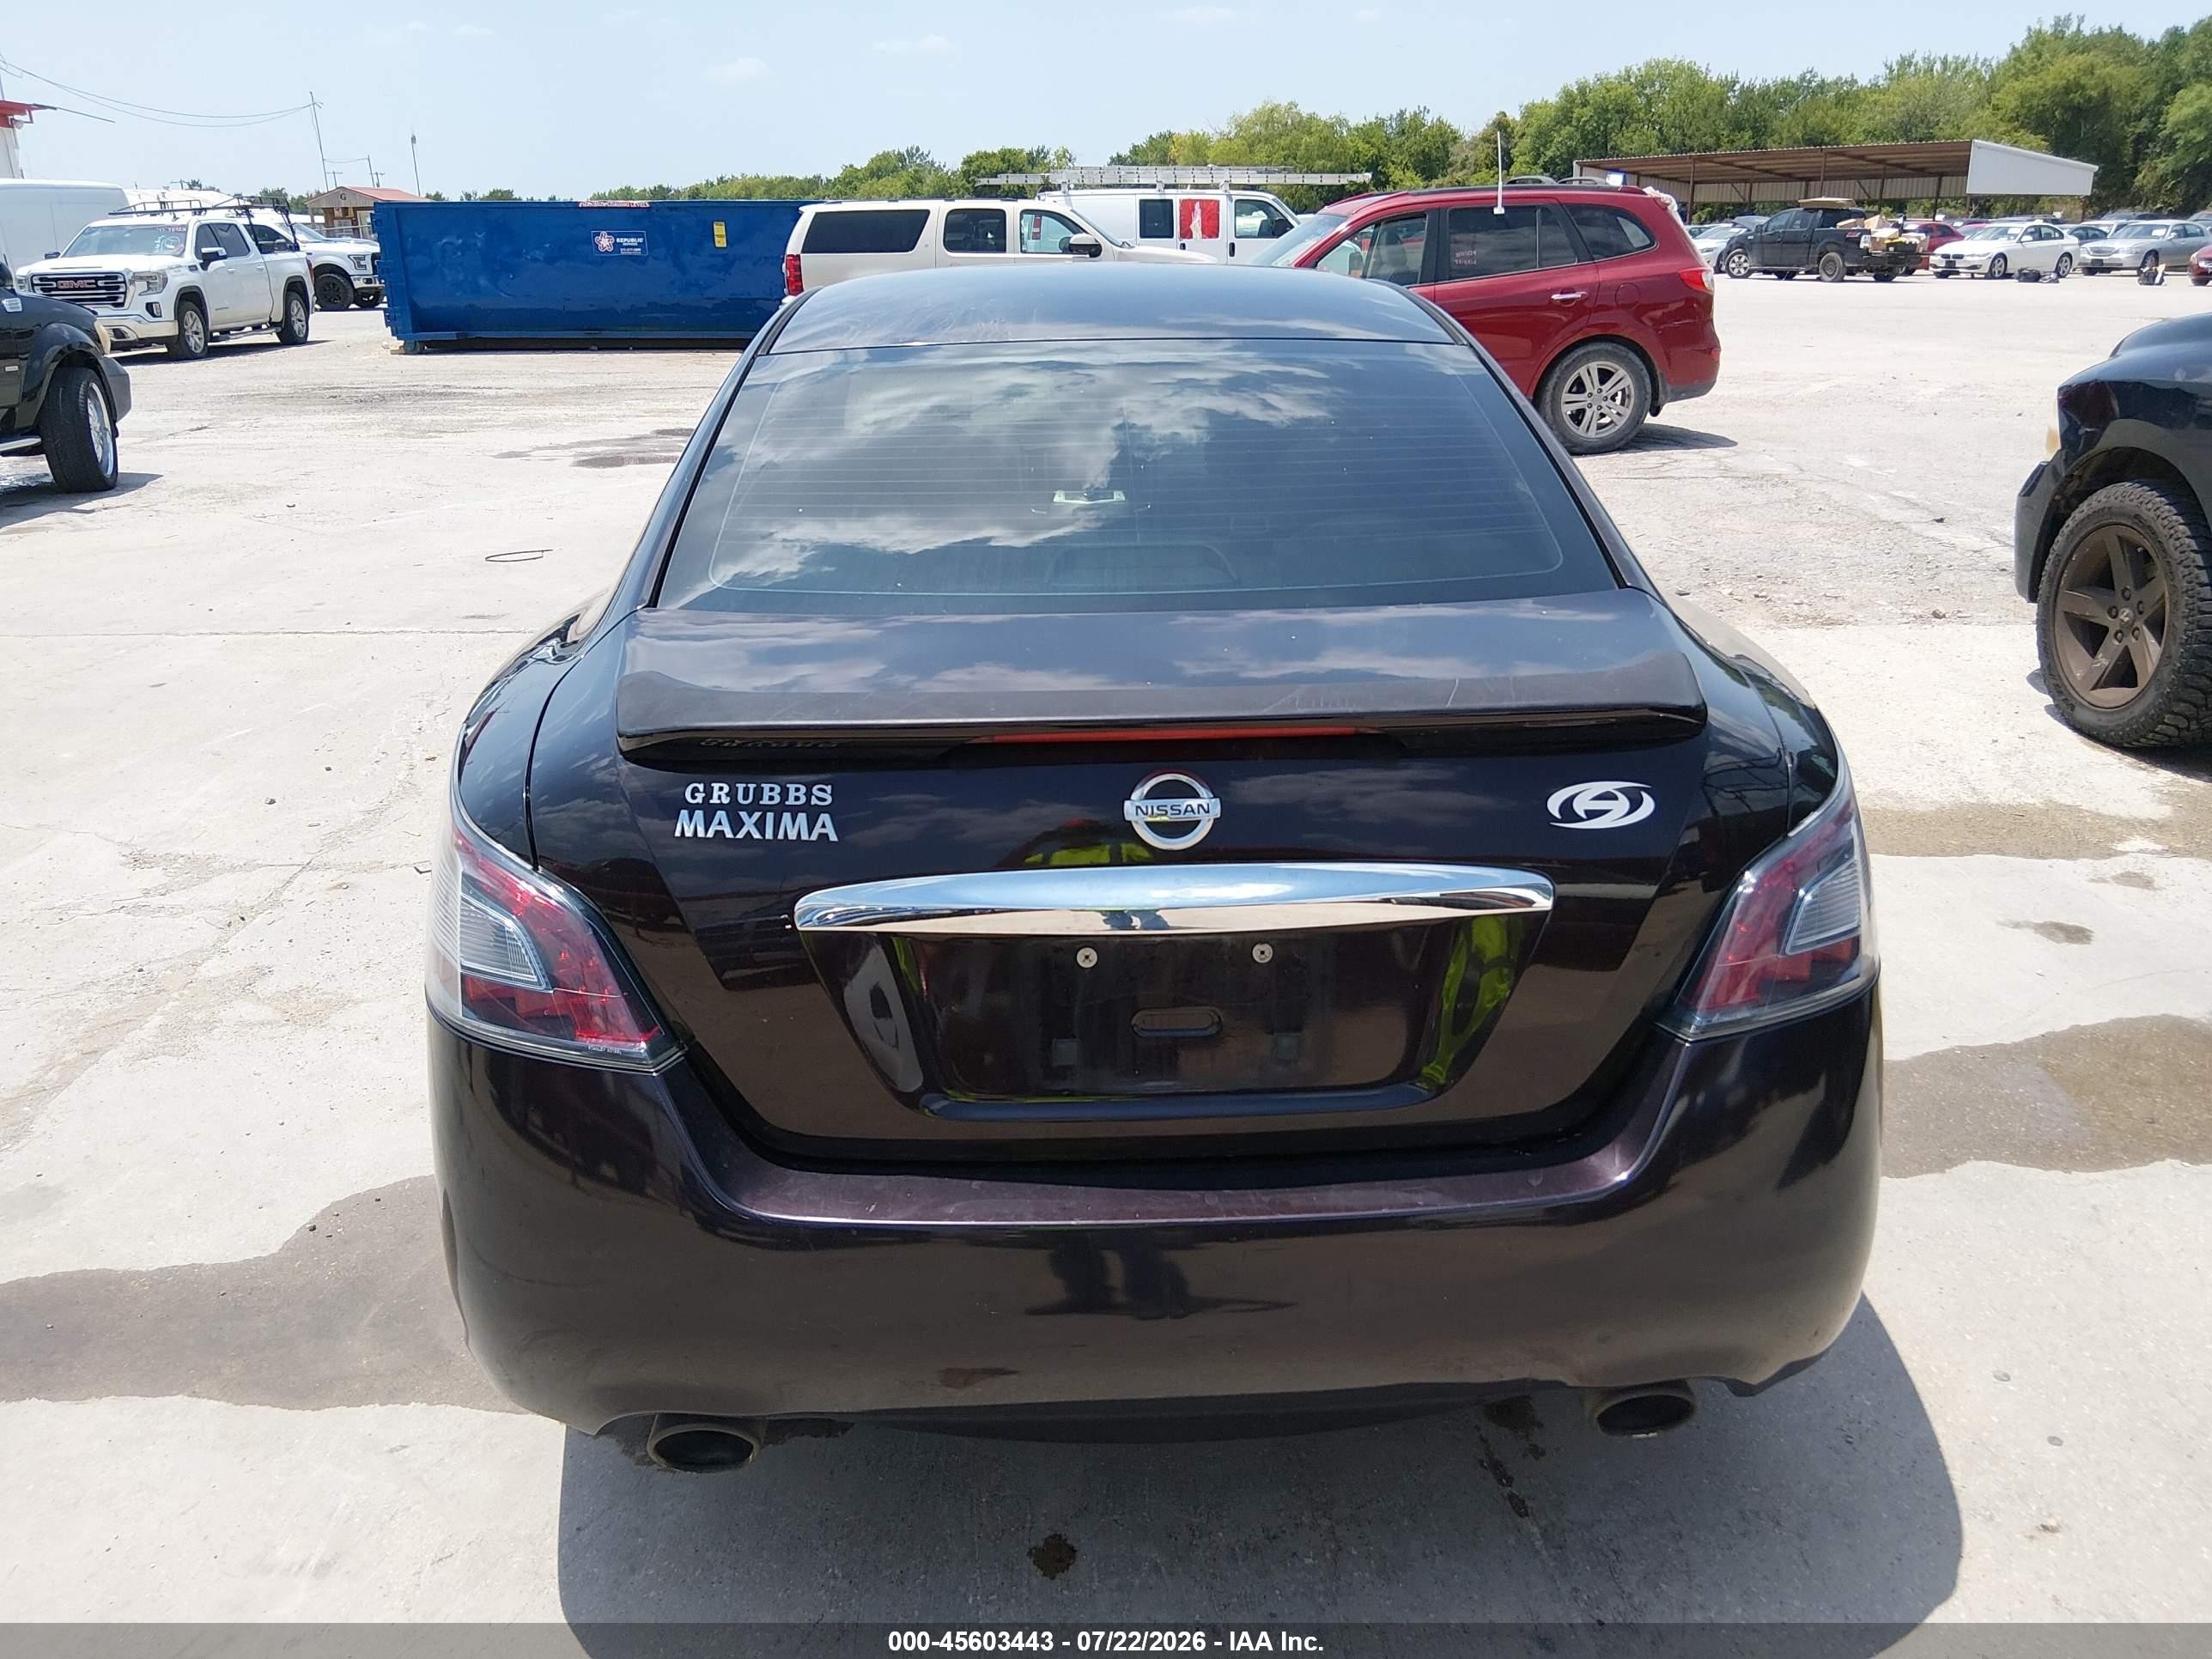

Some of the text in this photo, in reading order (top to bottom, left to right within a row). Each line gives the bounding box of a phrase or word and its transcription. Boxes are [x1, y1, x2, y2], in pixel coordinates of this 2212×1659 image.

[57, 279, 97, 289] GMC
[684, 782, 833, 805] GRUBBS
[1135, 803, 1210, 817] NISSAN
[674, 809, 839, 842] MAXIMA
